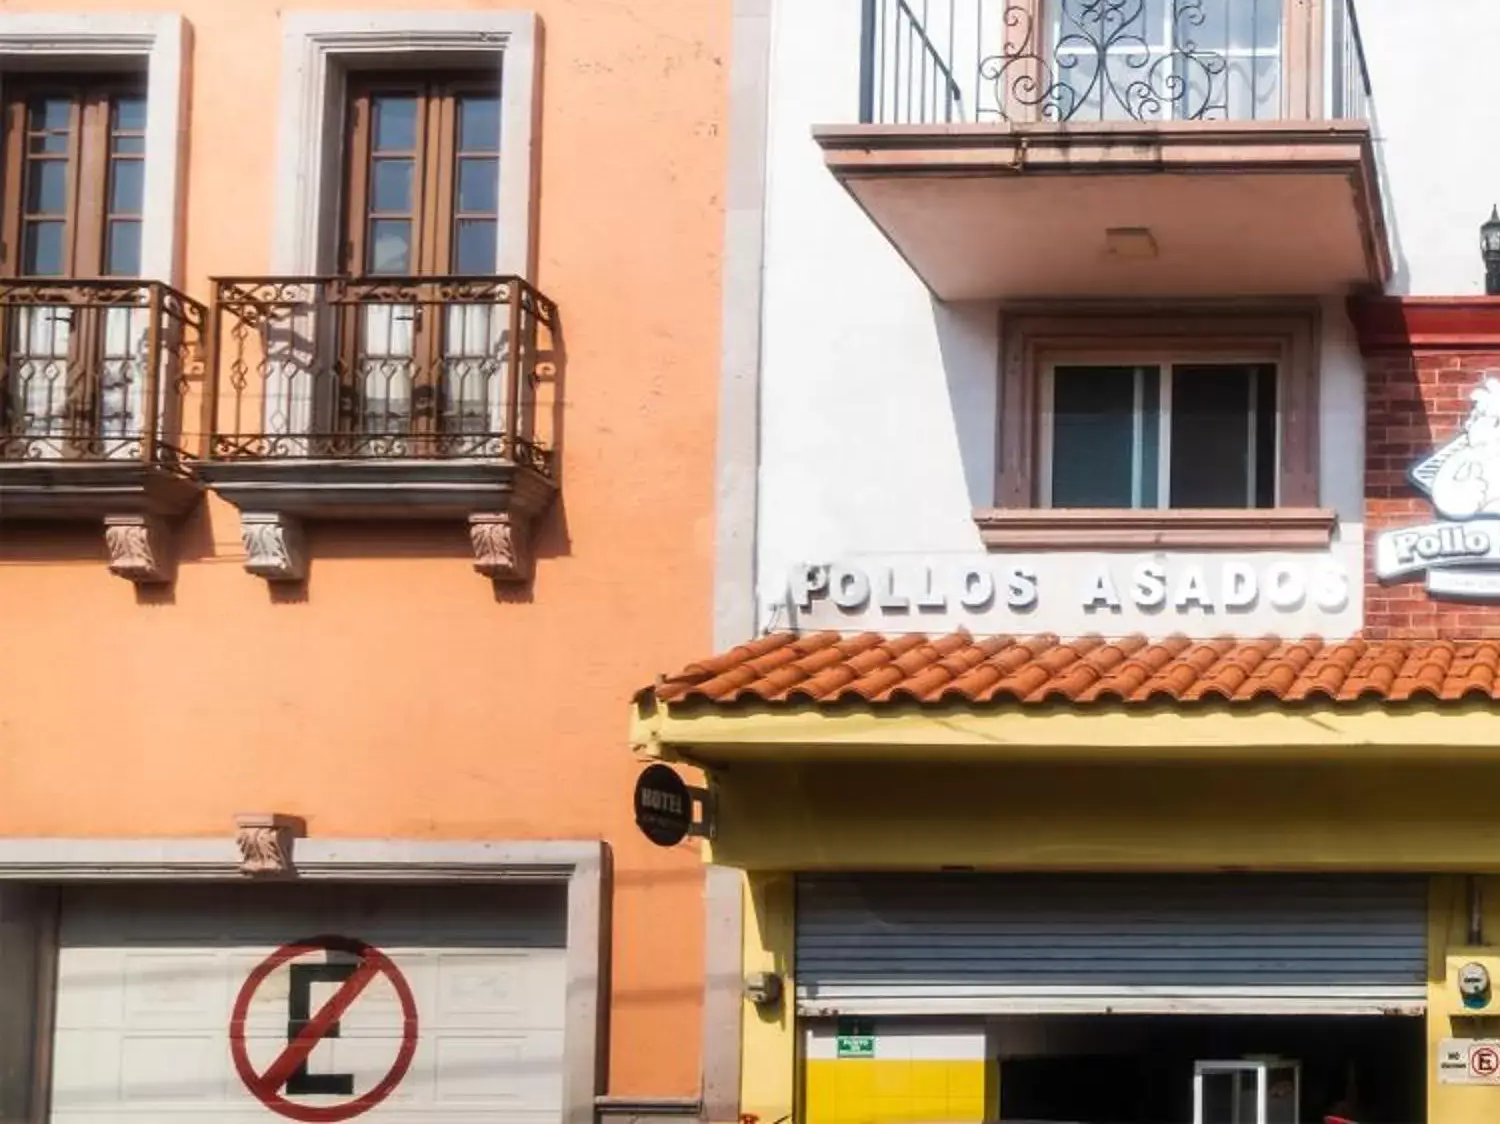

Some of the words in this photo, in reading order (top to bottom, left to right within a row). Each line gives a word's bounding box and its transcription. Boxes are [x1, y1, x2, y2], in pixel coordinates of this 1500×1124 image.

[1394, 526, 1491, 564] Pollo
[793, 561, 1040, 613] POLLOS
[1080, 558, 1350, 614] ASADOS
[641, 787, 683, 814] HOTEL
